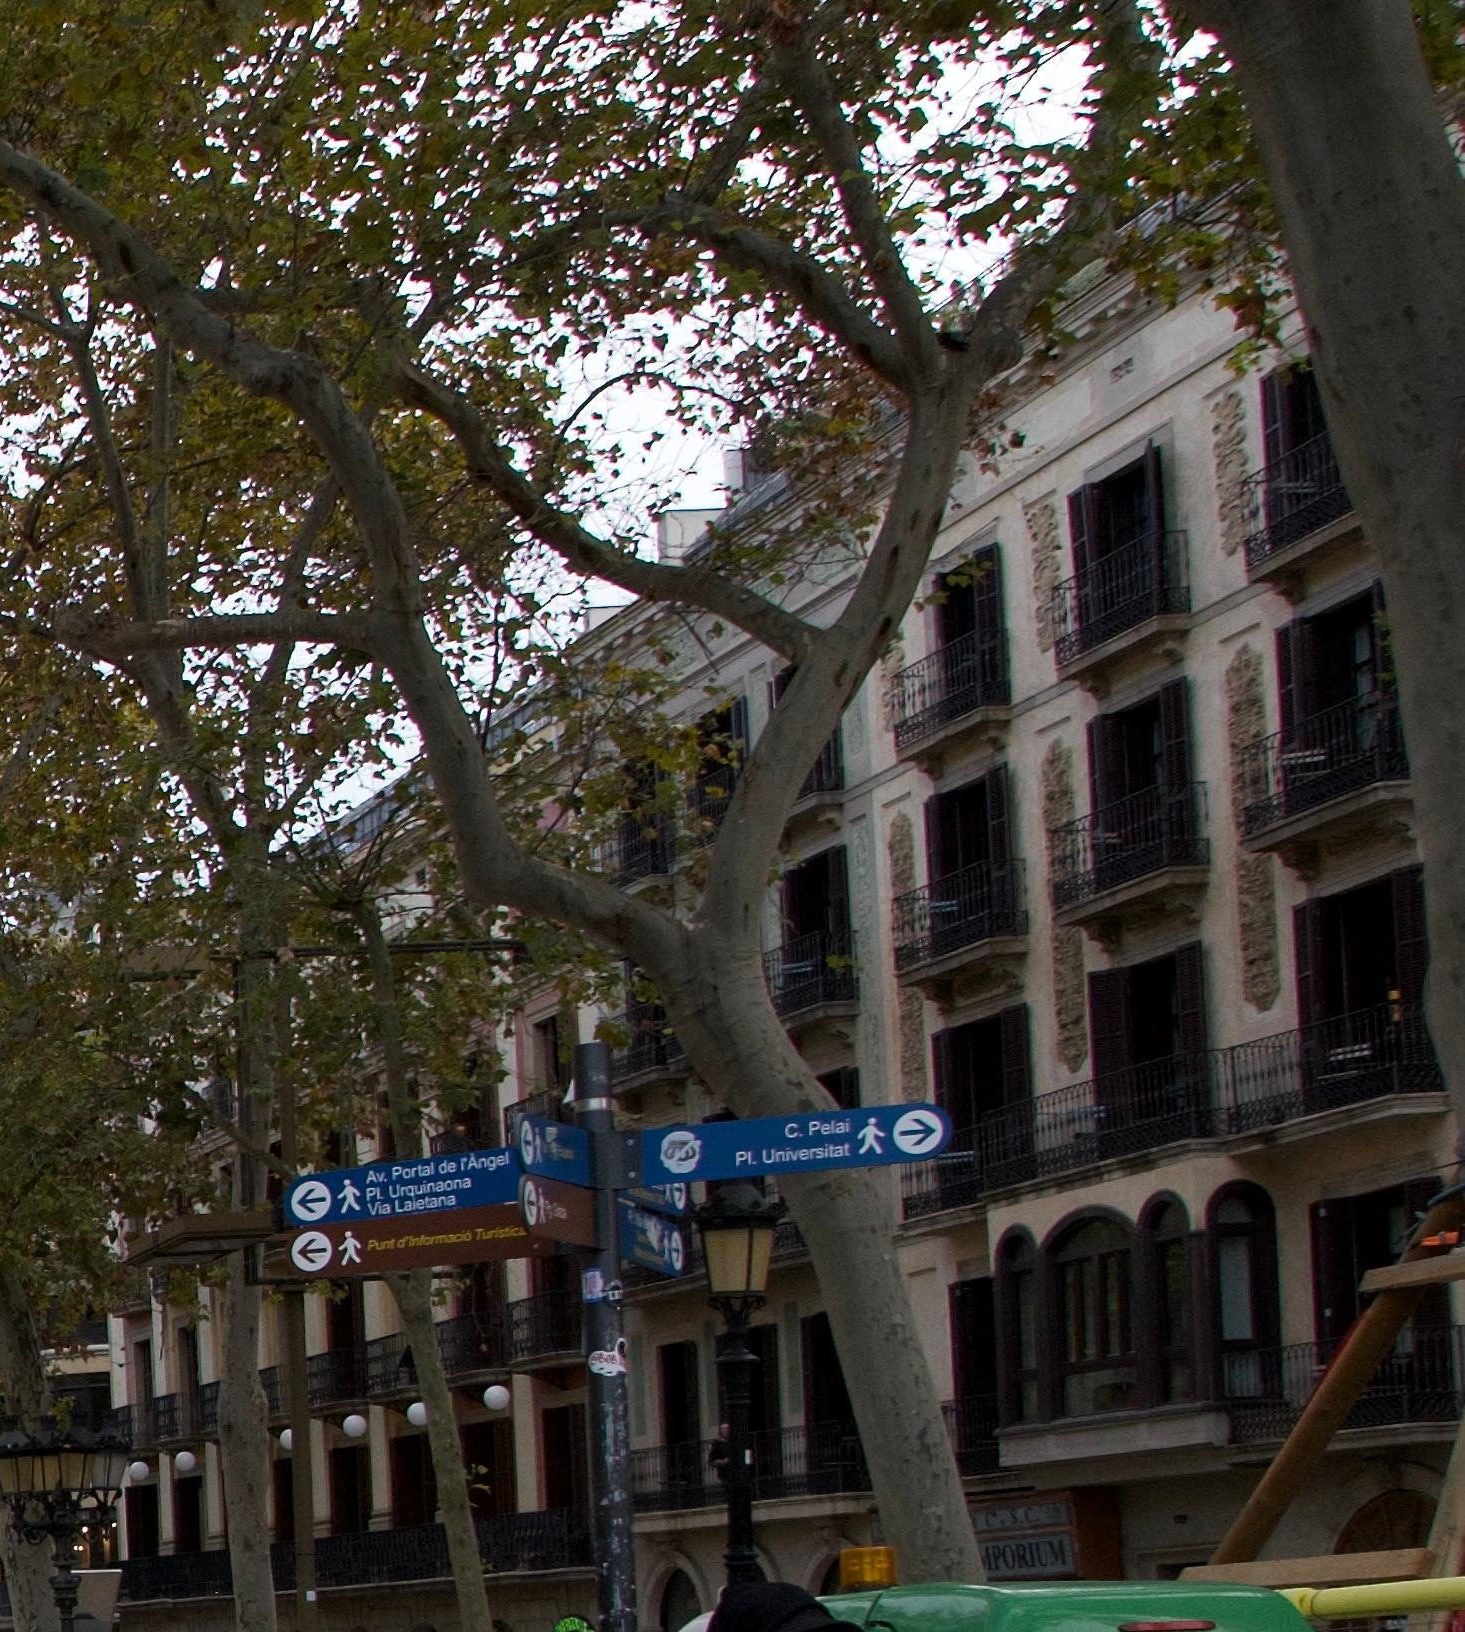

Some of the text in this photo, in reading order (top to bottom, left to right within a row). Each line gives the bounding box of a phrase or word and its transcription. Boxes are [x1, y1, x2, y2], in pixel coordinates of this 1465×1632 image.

[784, 1118, 851, 1138] C. Pelai
[735, 1142, 851, 1167] Pl. Universitat
[365, 1151, 511, 1185] Av. Portal de l'Àngel
[365, 1177, 472, 1201] Pl. Urquinaona
[367, 1194, 457, 1216] Via Laietana
[367, 1237, 396, 1251] Punt
[397, 1229, 472, 1249] d'Informació
[982, 1539, 1067, 1571] PORIUM
